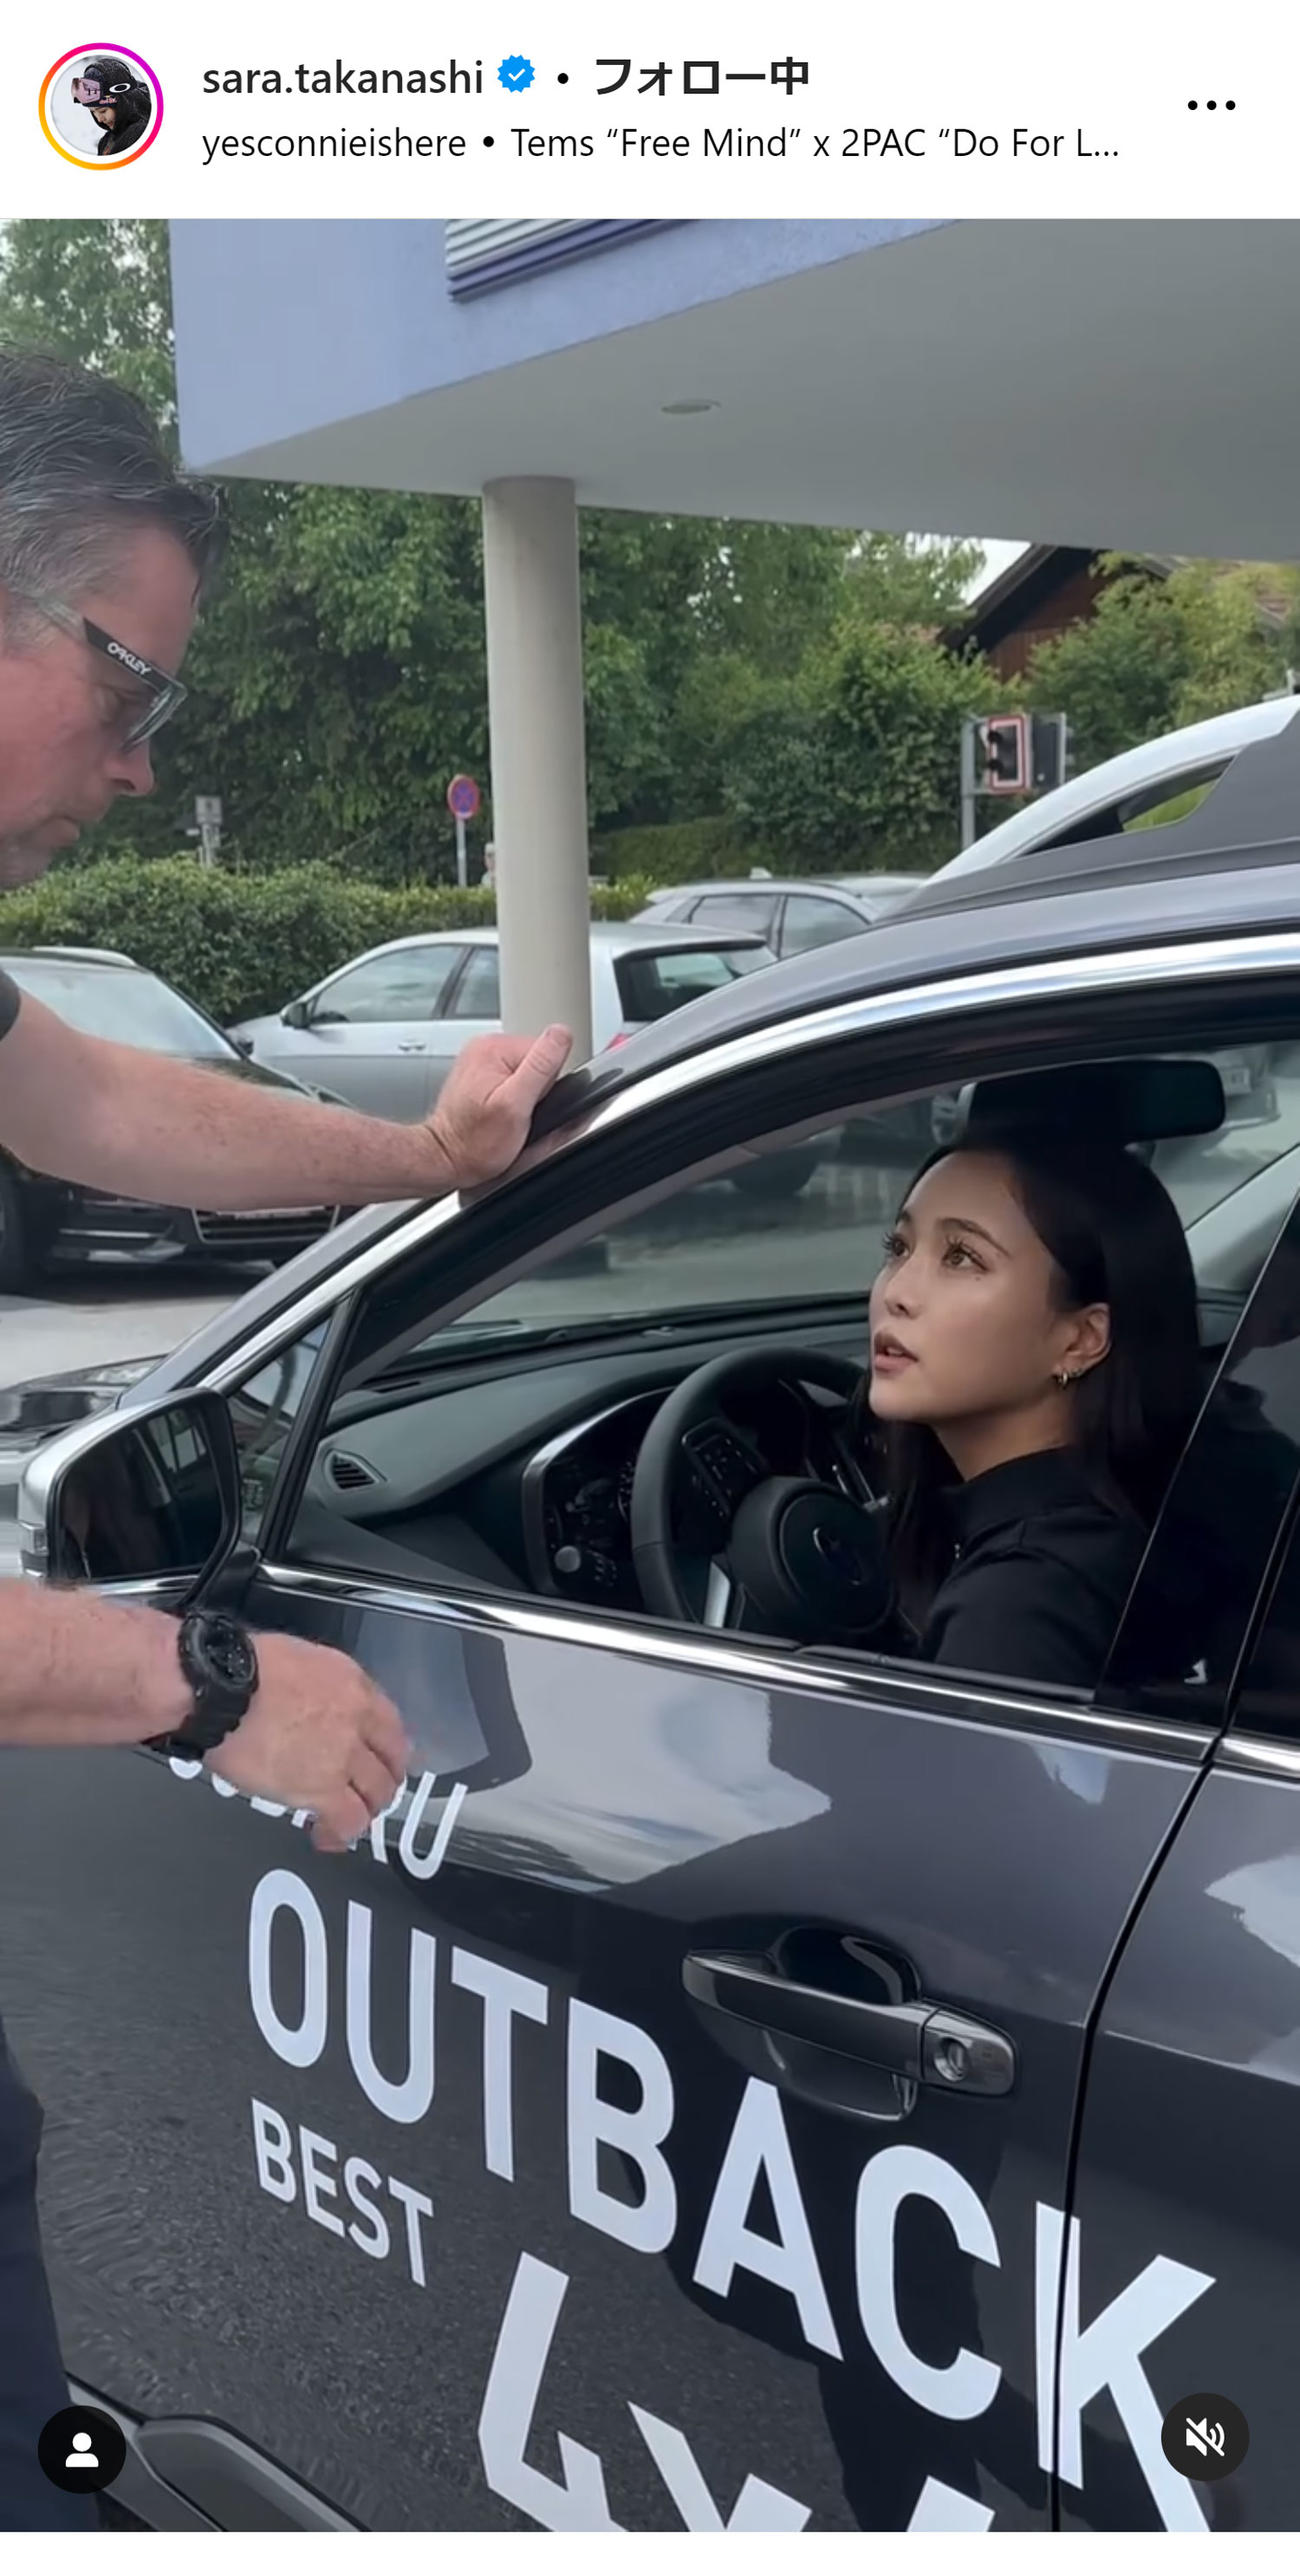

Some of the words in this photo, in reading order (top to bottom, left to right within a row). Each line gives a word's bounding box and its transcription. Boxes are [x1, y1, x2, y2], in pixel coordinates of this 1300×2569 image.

[107, 642, 151, 675] OAKLEY
[249, 1868, 1216, 2532] OUTBACK
[251, 2098, 434, 2287] BEST
